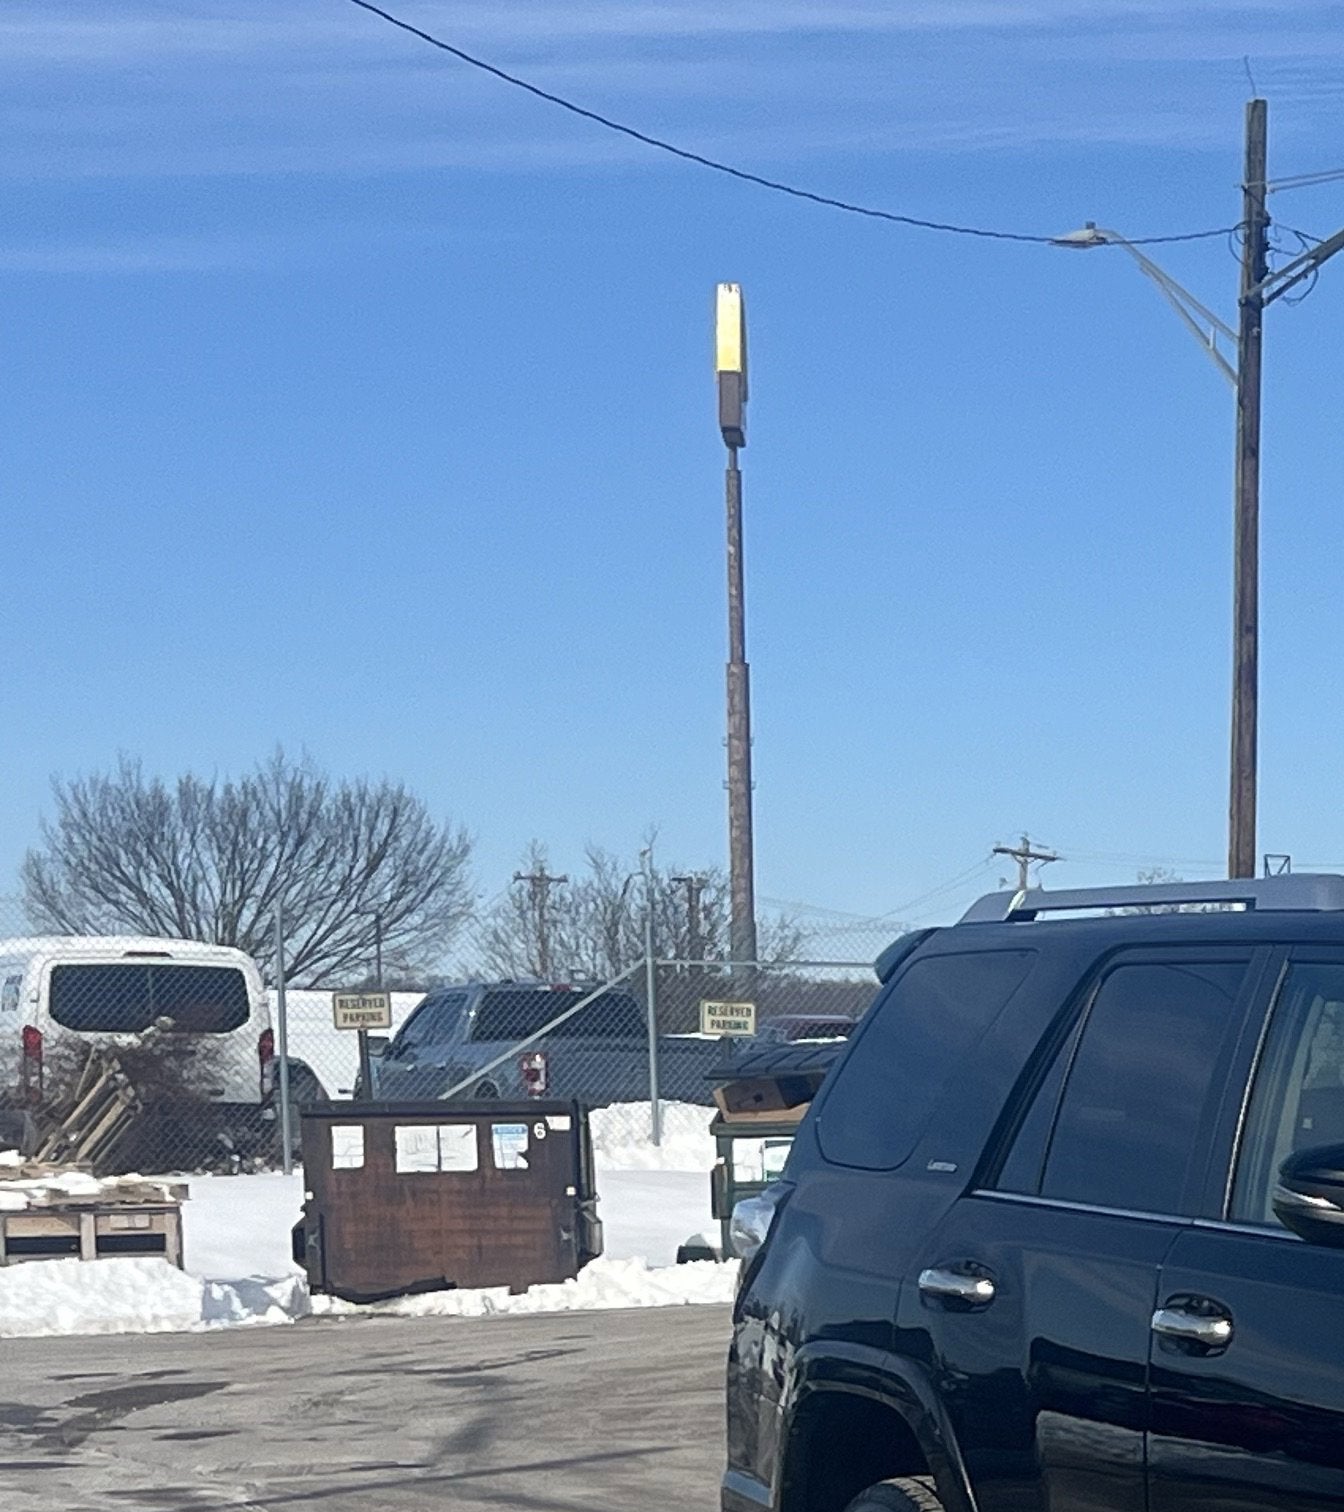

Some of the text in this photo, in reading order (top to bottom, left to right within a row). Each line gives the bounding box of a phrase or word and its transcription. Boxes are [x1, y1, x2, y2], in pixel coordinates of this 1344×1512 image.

[338, 998, 384, 1009] RESERVED
[708, 1005, 752, 1017] RESERVED
[342, 1011, 383, 1023] PARKING
[711, 1019, 749, 1030] PARKING
